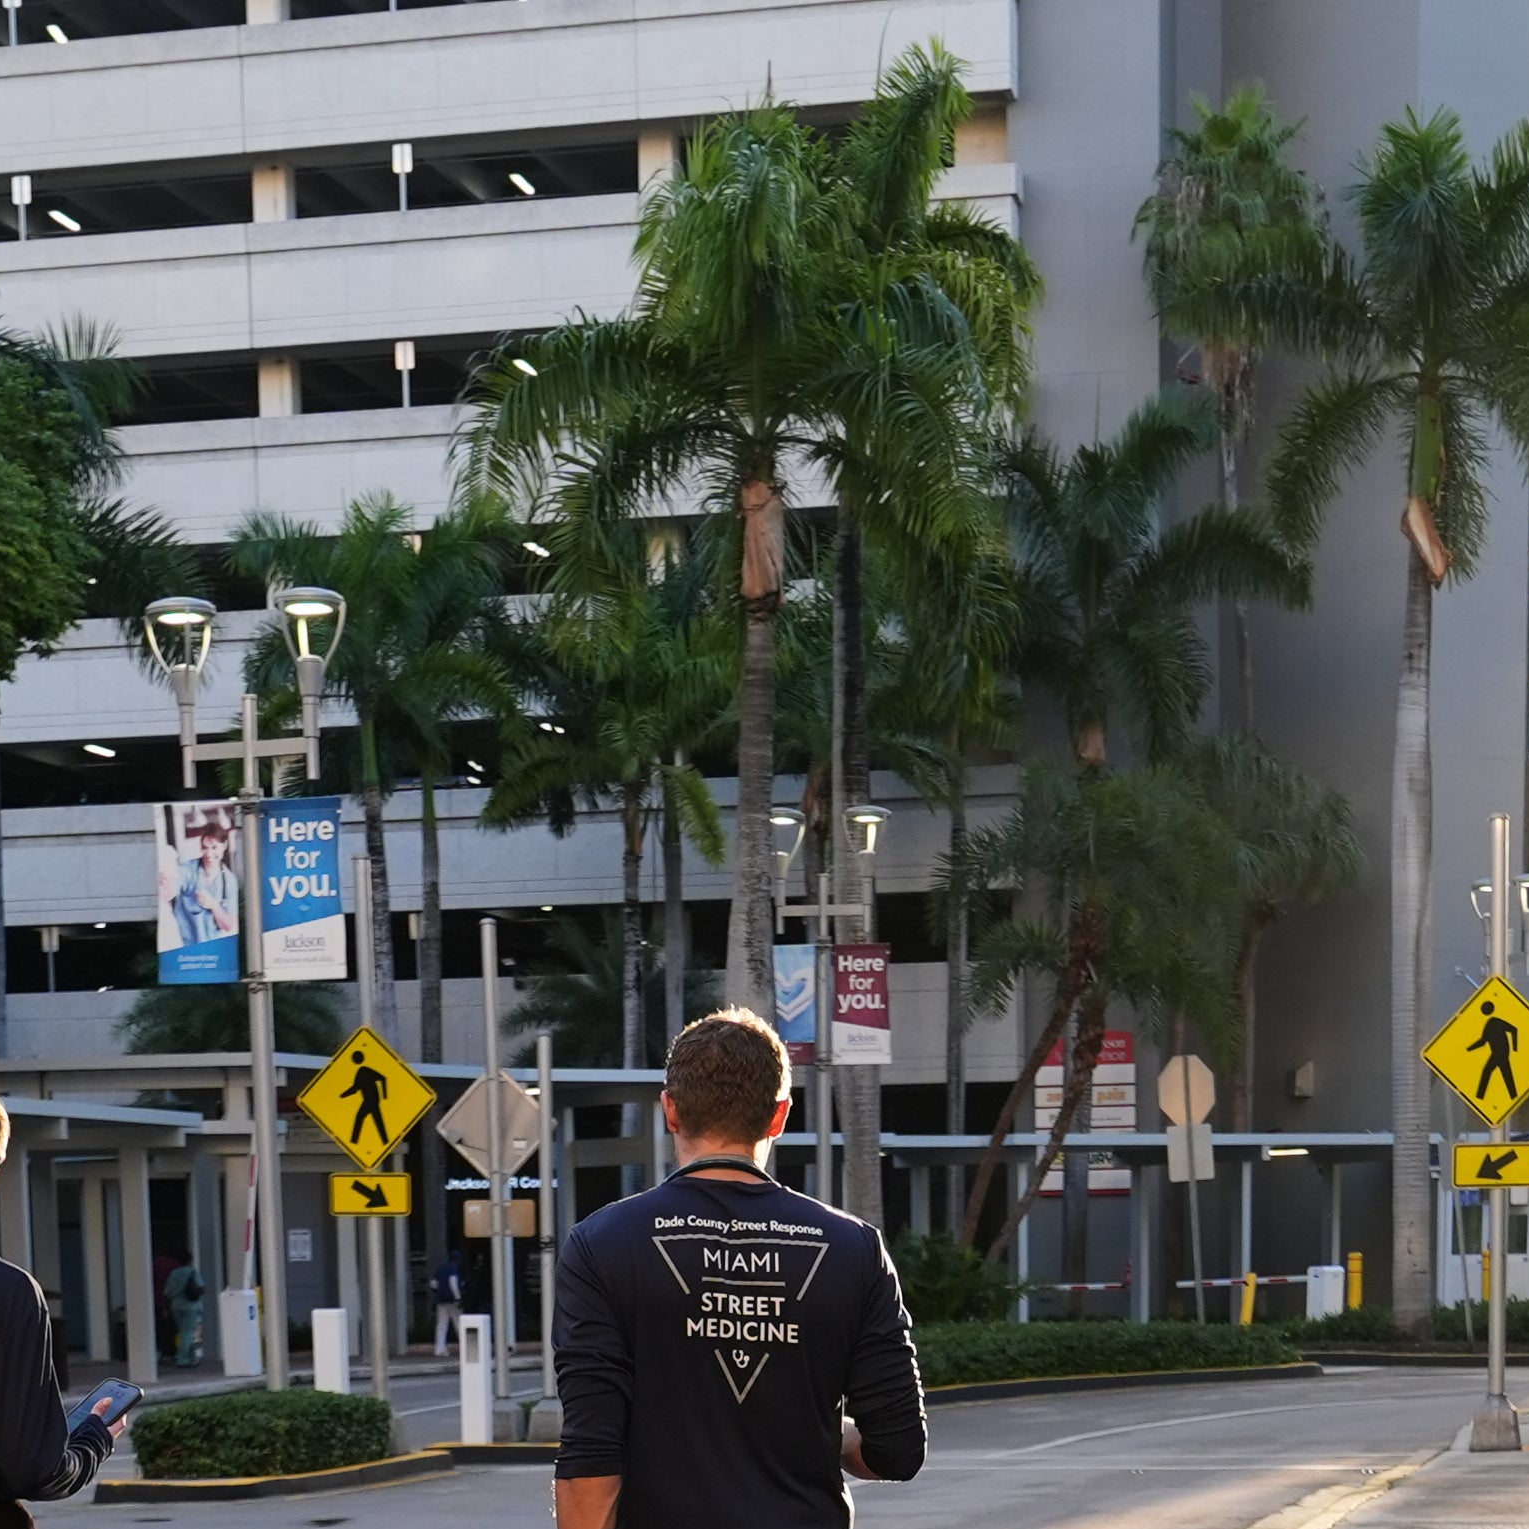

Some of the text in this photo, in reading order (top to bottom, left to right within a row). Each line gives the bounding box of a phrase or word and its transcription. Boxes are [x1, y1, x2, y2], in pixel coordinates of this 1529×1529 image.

[268, 817, 335, 842] Here
[284, 846, 321, 869] for
[268, 874, 337, 905] you.
[837, 955, 885, 972] Here
[848, 974, 875, 990] for
[837, 993, 886, 1014] you.
[445, 1177, 490, 1190] Jackso
[655, 1215, 823, 1236] Dade County Street Response
[703, 1247, 780, 1273] MIAMI
[701, 1292, 786, 1317] STREET
[686, 1317, 799, 1344] MEDICINE
